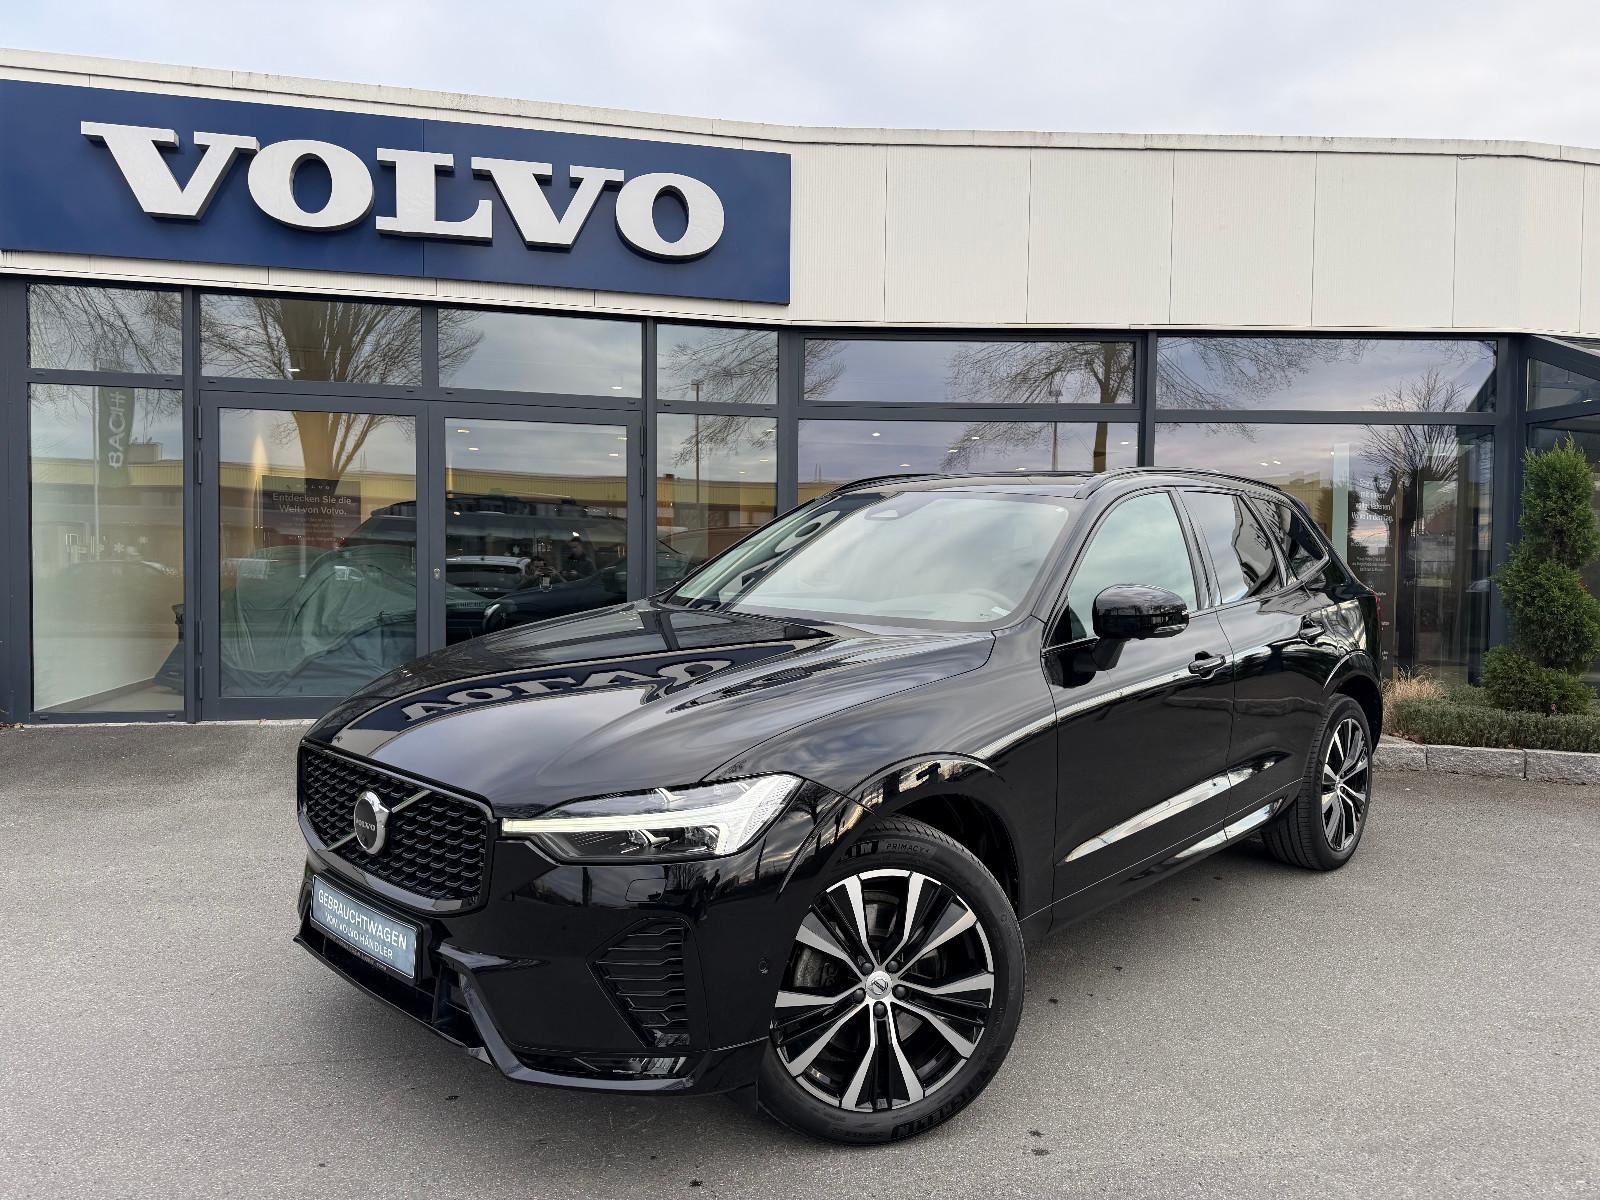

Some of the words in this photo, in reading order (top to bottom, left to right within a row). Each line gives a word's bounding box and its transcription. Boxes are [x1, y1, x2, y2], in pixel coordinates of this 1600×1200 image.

[80, 120, 725, 260] VOLVO
[272, 492, 320, 503] Entdecken
[322, 495, 336, 504] Sie
[338, 496, 352, 505] die
[279, 504, 301, 513] Welt
[302, 506, 319, 514] von
[318, 889, 407, 951] GEBRAUCHTWAGEN
[339, 921, 359, 941] VOLVO
[359, 933, 394, 960] HÄNDLER
